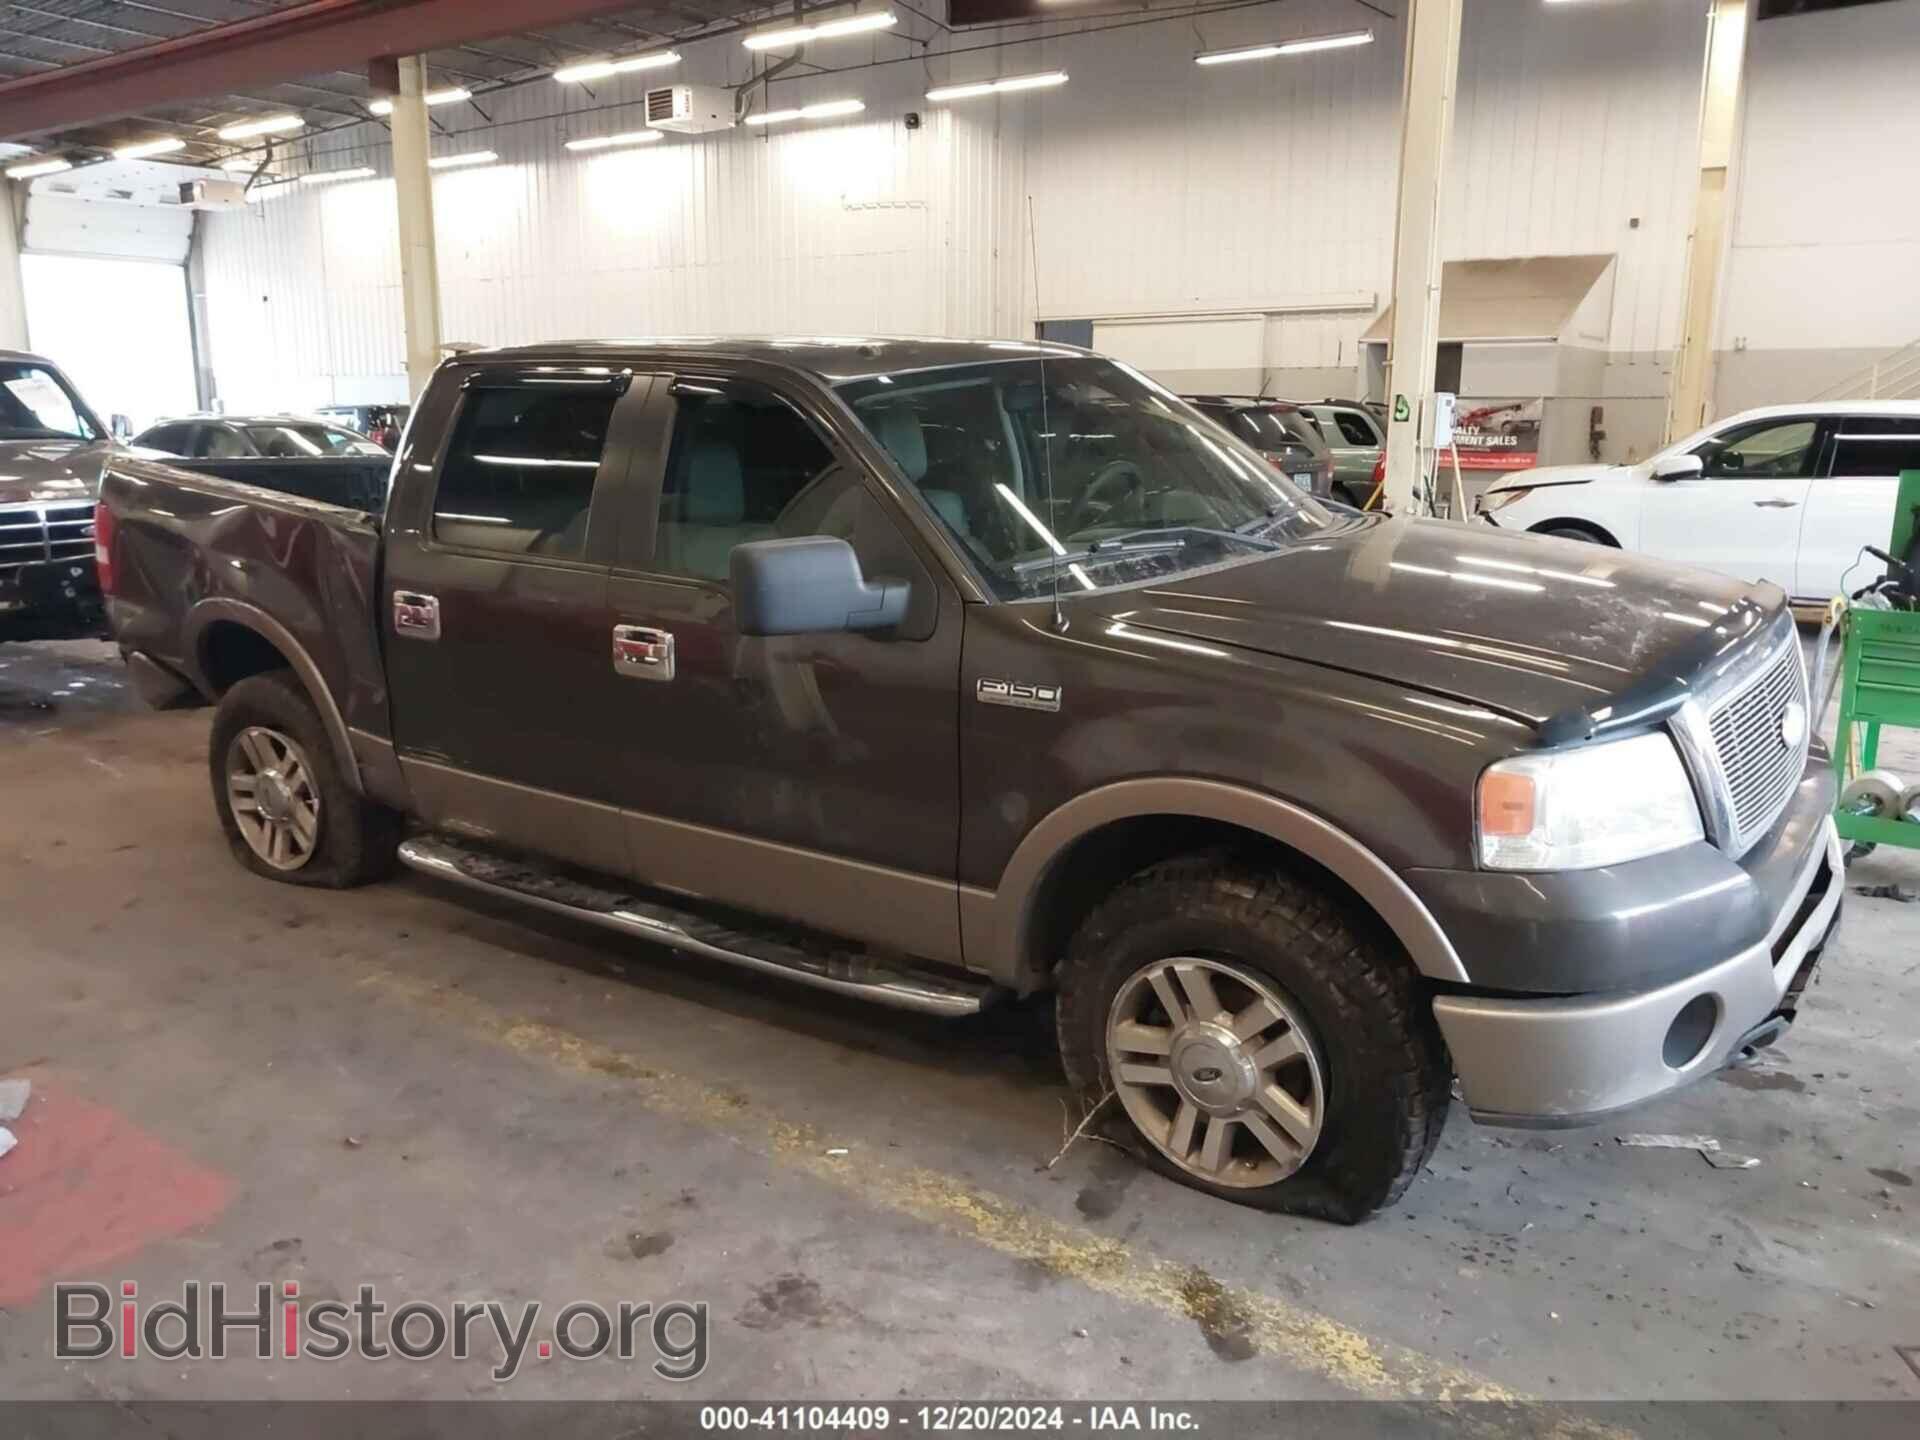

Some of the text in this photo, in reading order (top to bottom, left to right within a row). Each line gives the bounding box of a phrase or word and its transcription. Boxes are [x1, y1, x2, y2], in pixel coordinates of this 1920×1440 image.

[1455, 425, 1480, 435] ALTY
[1455, 435, 1518, 446] MENT SALES
